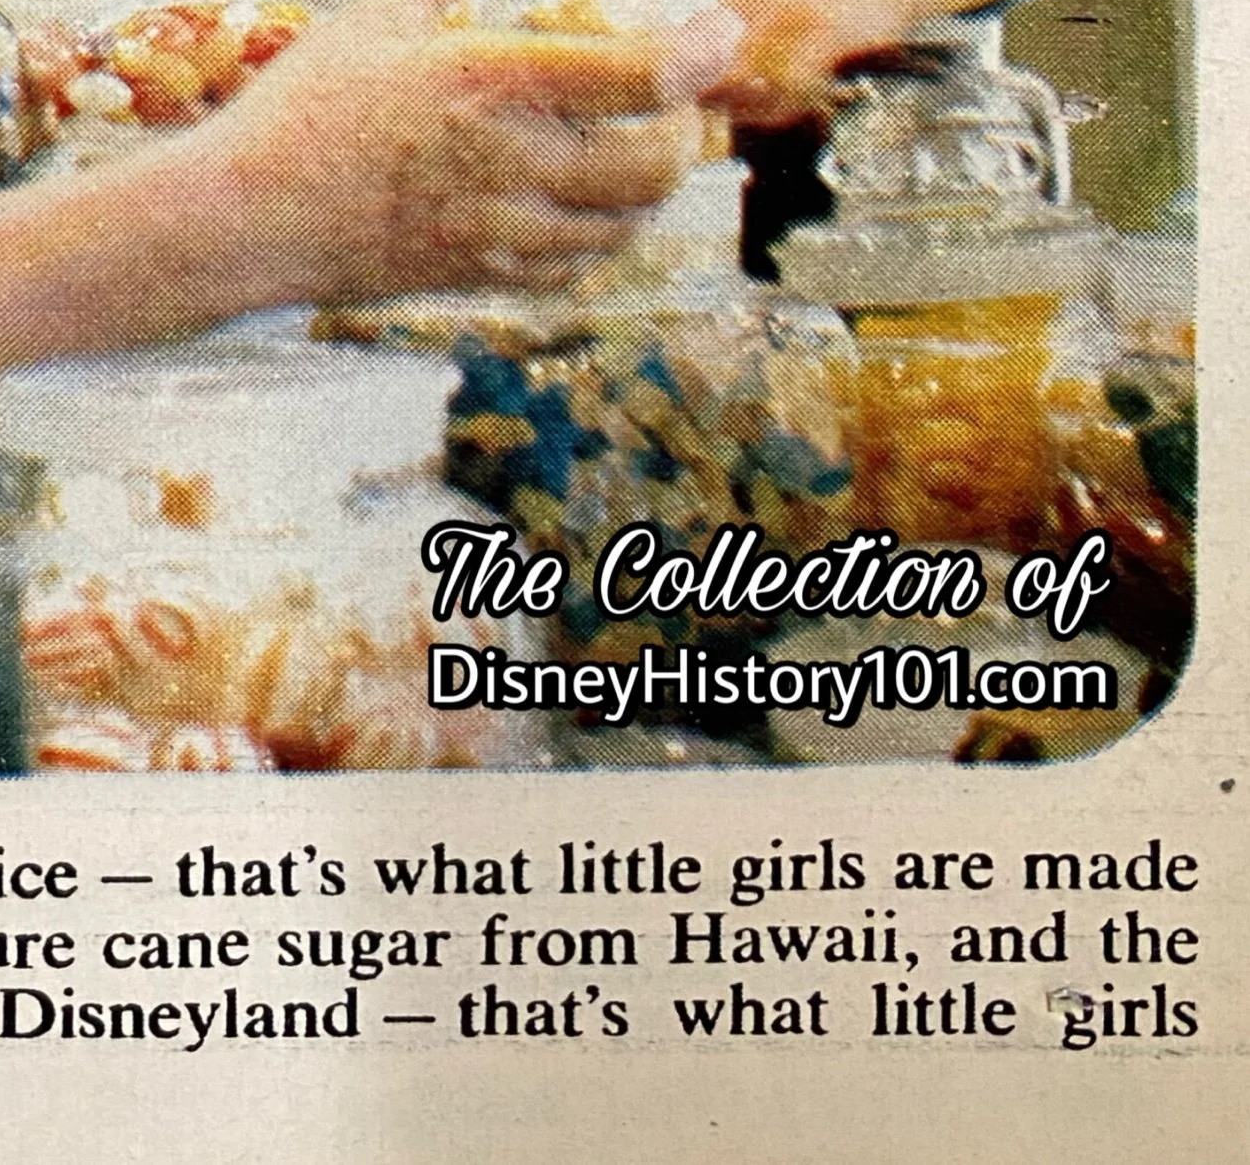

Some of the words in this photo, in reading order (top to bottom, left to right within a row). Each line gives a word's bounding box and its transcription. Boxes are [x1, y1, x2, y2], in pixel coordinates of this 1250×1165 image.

[175, 844, 346, 898] that’s
[373, 842, 533, 896] what
[559, 840, 702, 895] little
[729, 838, 866, 907] girls
[894, 852, 994, 891] are
[1023, 838, 1199, 893] made
[102, 930, 250, 970] cane
[277, 929, 452, 981] sugar
[479, 912, 639, 967] from
[668, 908, 919, 973] Hawaii,
[950, 909, 1069, 963] and
[1099, 909, 1199, 966] the
[457, 983, 629, 1039] that’s
[673, 981, 829, 1037] what
[871, 981, 1017, 1037] little
[1057, 981, 1199, 1052] girls
